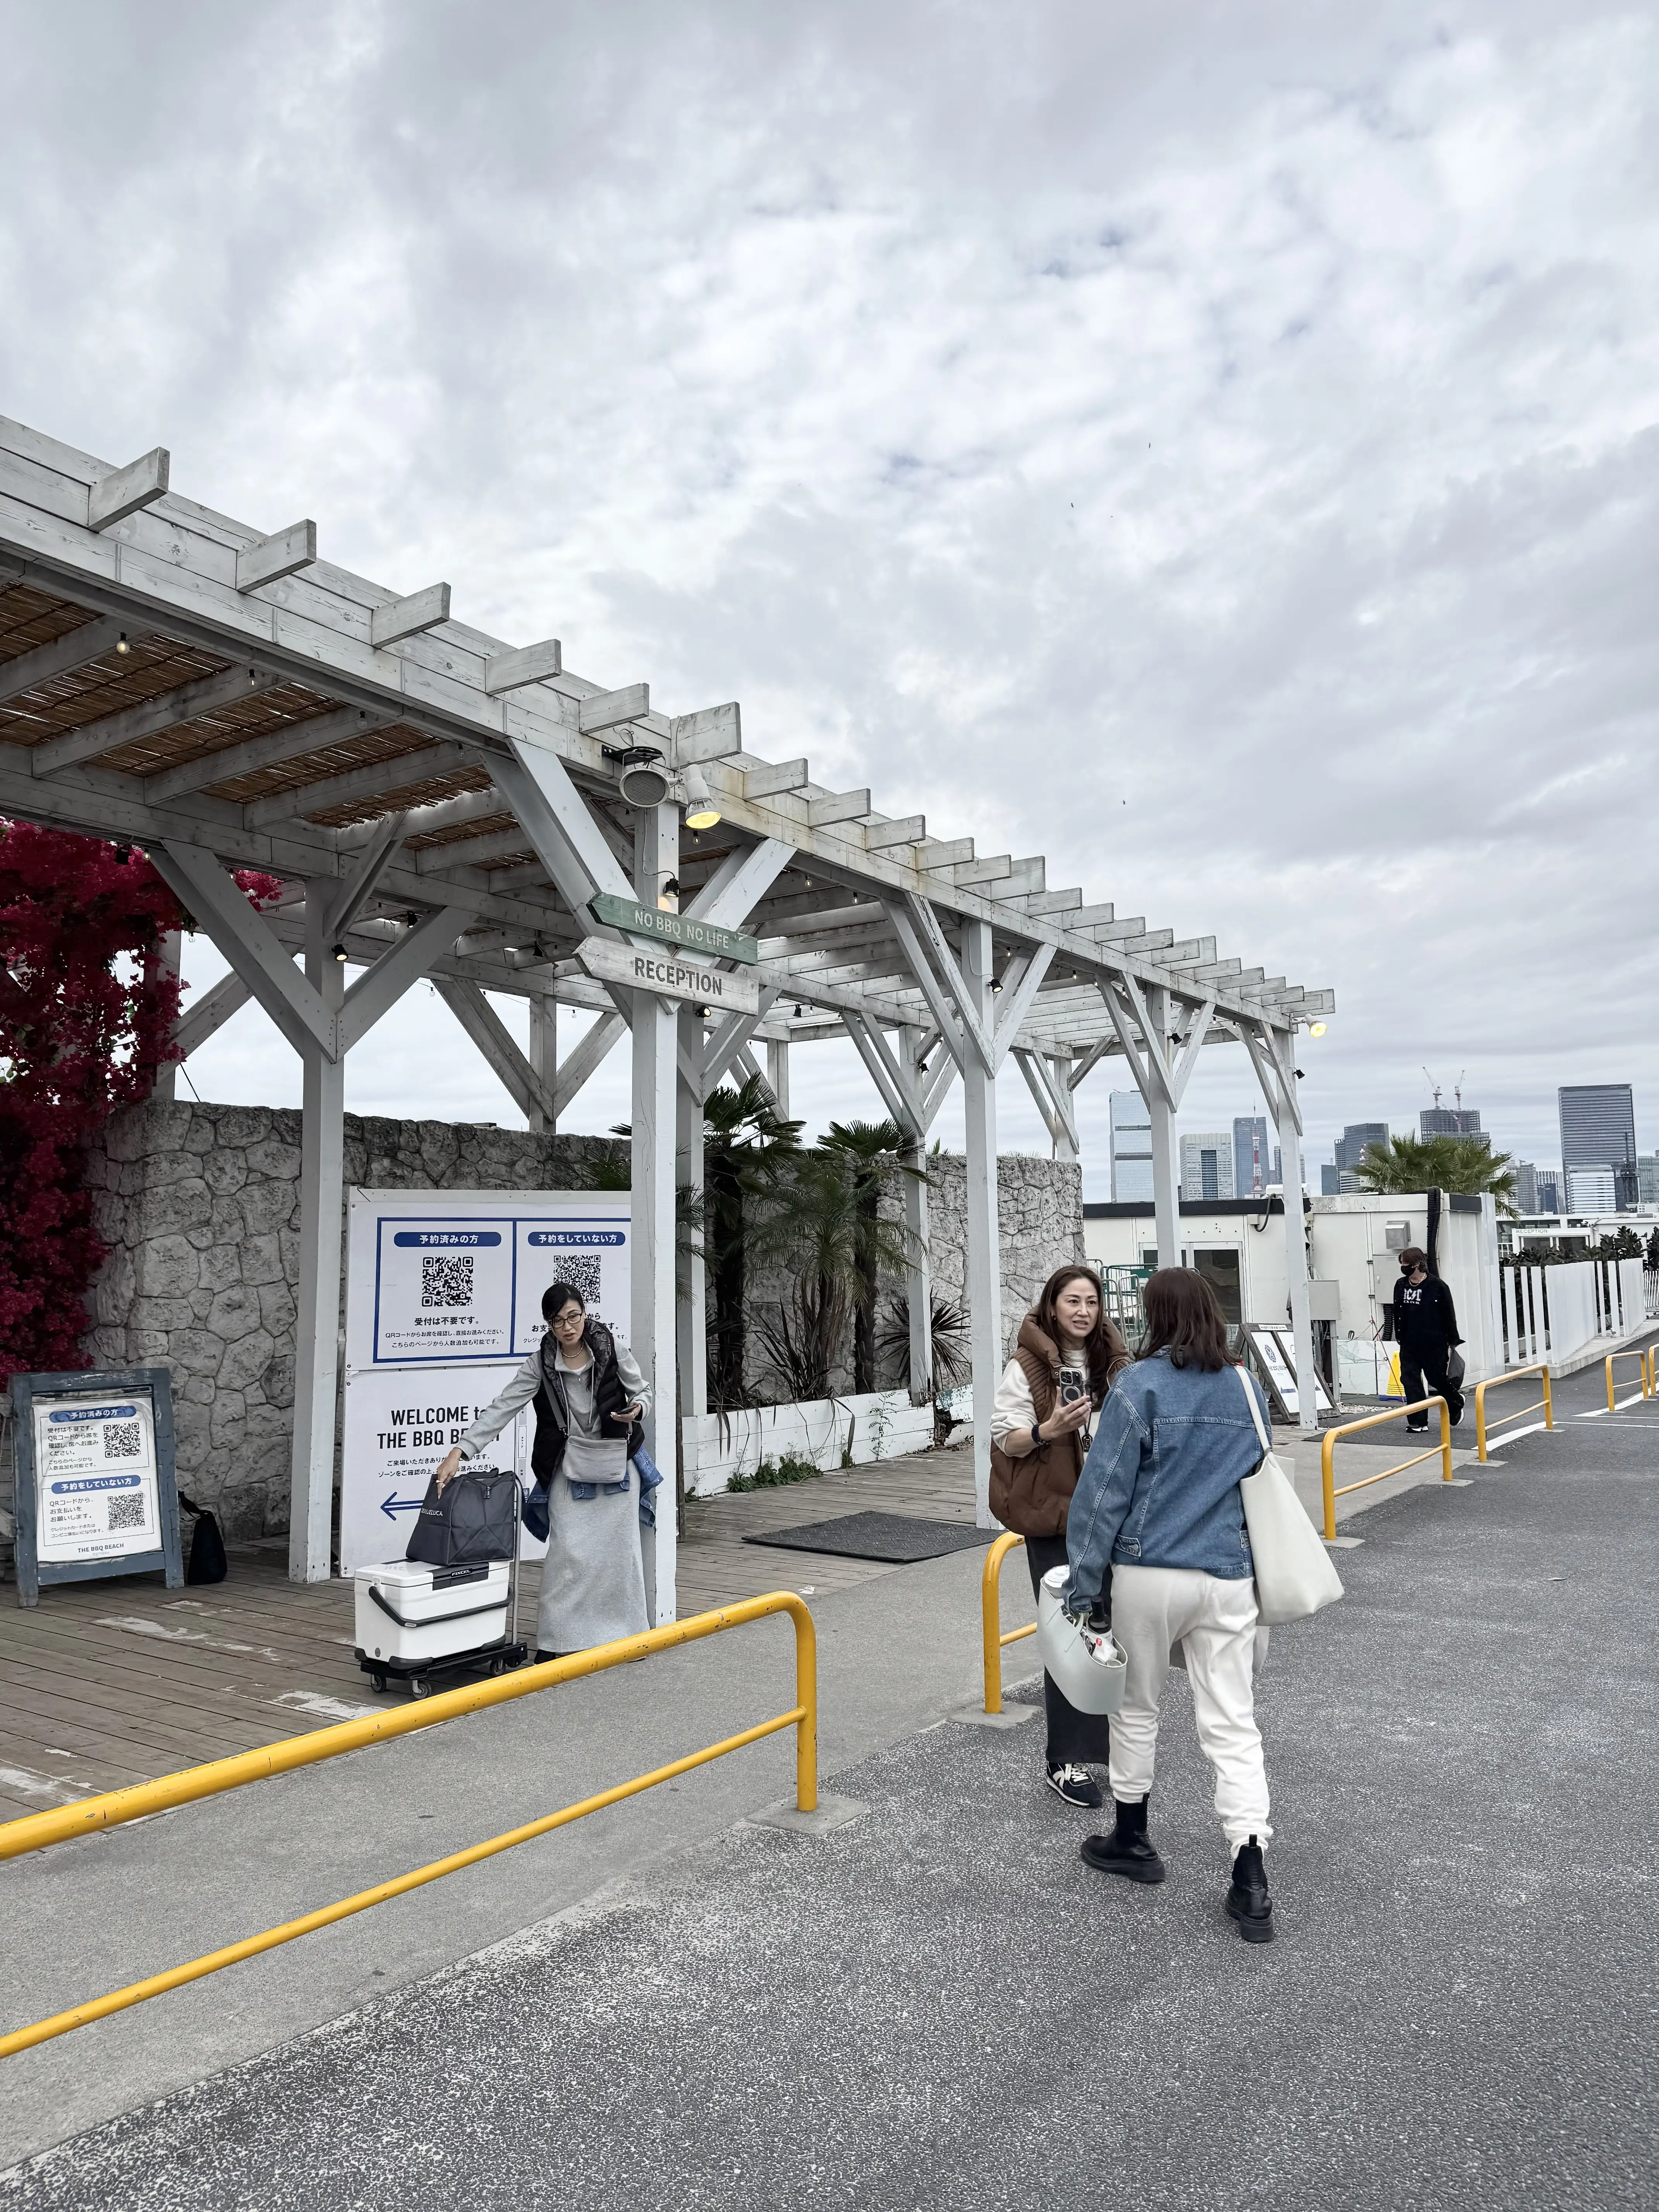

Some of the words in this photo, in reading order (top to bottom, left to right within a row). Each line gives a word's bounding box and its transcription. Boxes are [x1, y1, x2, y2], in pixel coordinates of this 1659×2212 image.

[635, 910, 653, 928] NO
[656, 916, 681, 939] BBQ
[687, 924, 704, 941] NO
[706, 930, 729, 949] LIFE
[635, 957, 722, 996] RECEPTION
[419, 1235, 479, 1244] 予約済みの方
[539, 1234, 617, 1243] 予約をしていない方
[414, 1316, 479, 1326] 受付は不要です。
[70, 1409, 118, 1419] 予約済みの方
[391, 1406, 469, 1426] WELCOME
[474, 1407, 487, 1420] t
[377, 1432, 407, 1449] THE
[413, 1429, 445, 1447] BBQ
[61, 1477, 132, 1491] 予約をしていない方
[50, 1506, 82, 1515] お支払いを
